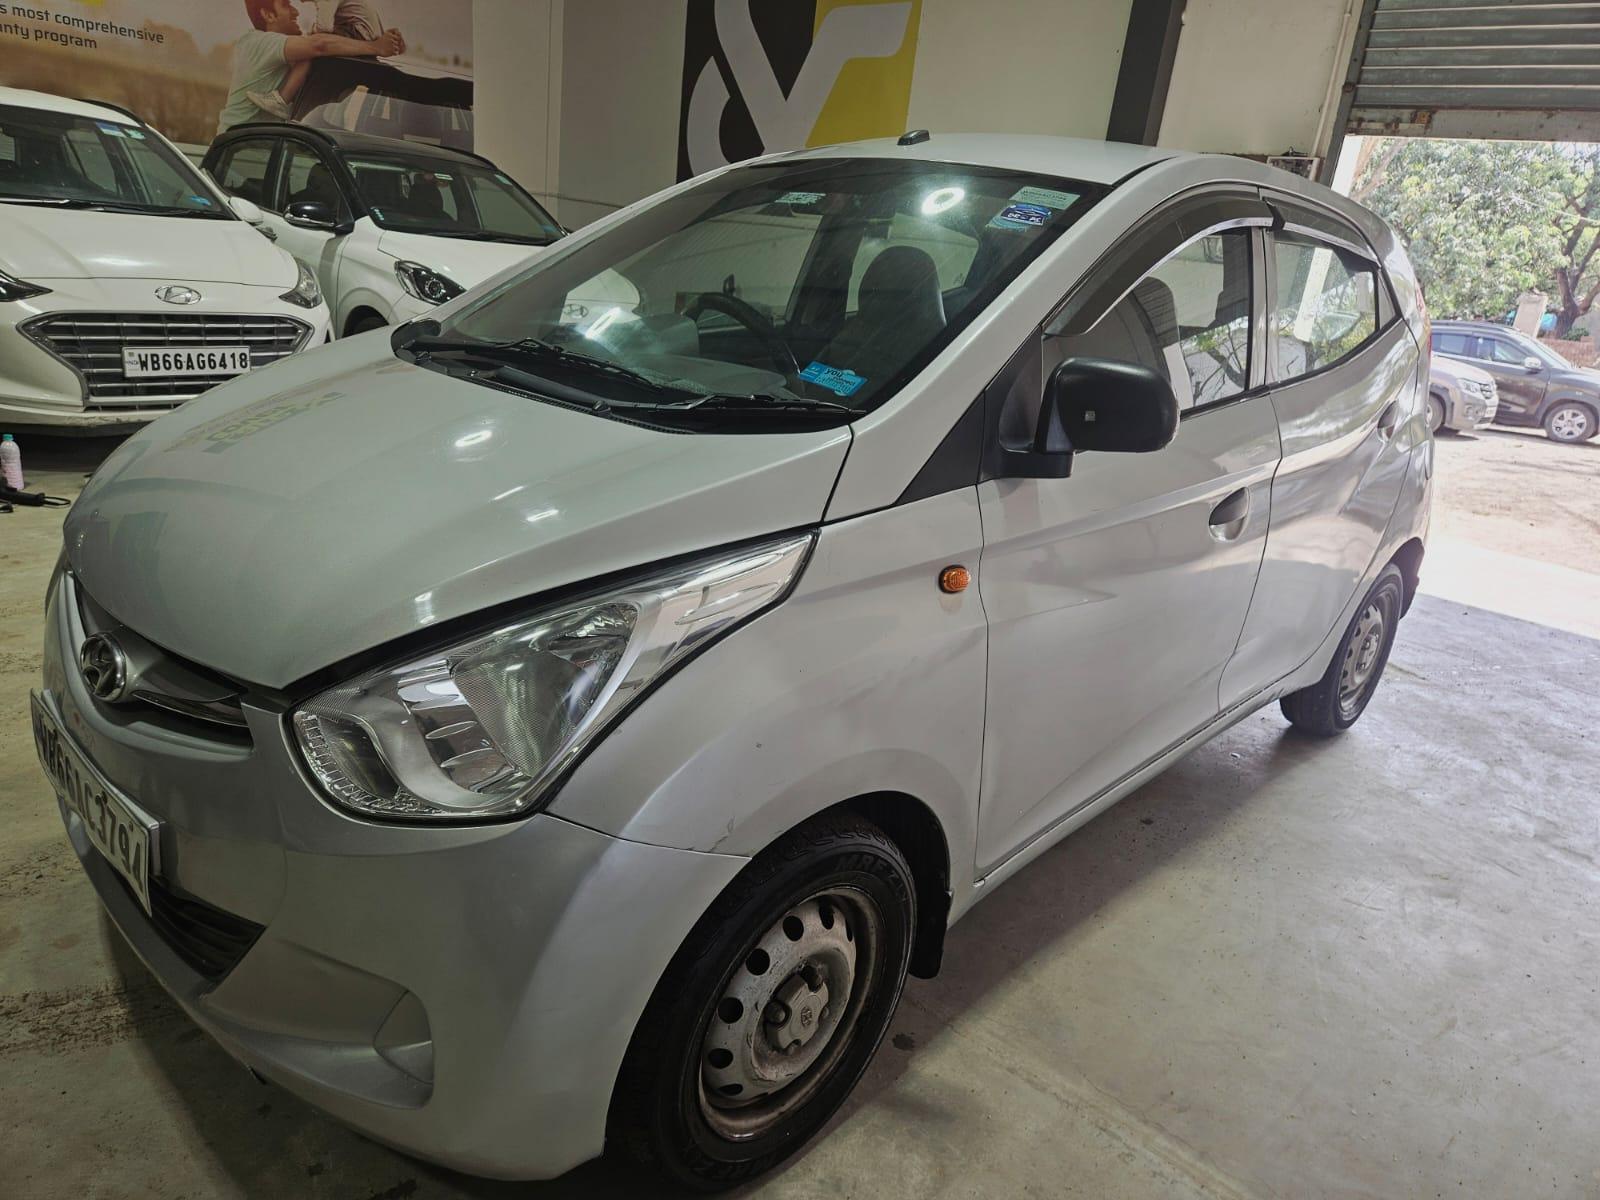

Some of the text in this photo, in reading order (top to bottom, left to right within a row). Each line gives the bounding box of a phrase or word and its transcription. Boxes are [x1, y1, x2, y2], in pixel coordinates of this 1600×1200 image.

[12, 6, 50, 21] most
[54, 13, 164, 44] comprehensive
[34, 28, 97, 49] program
[138, 352, 248, 371] WB66AG6418
